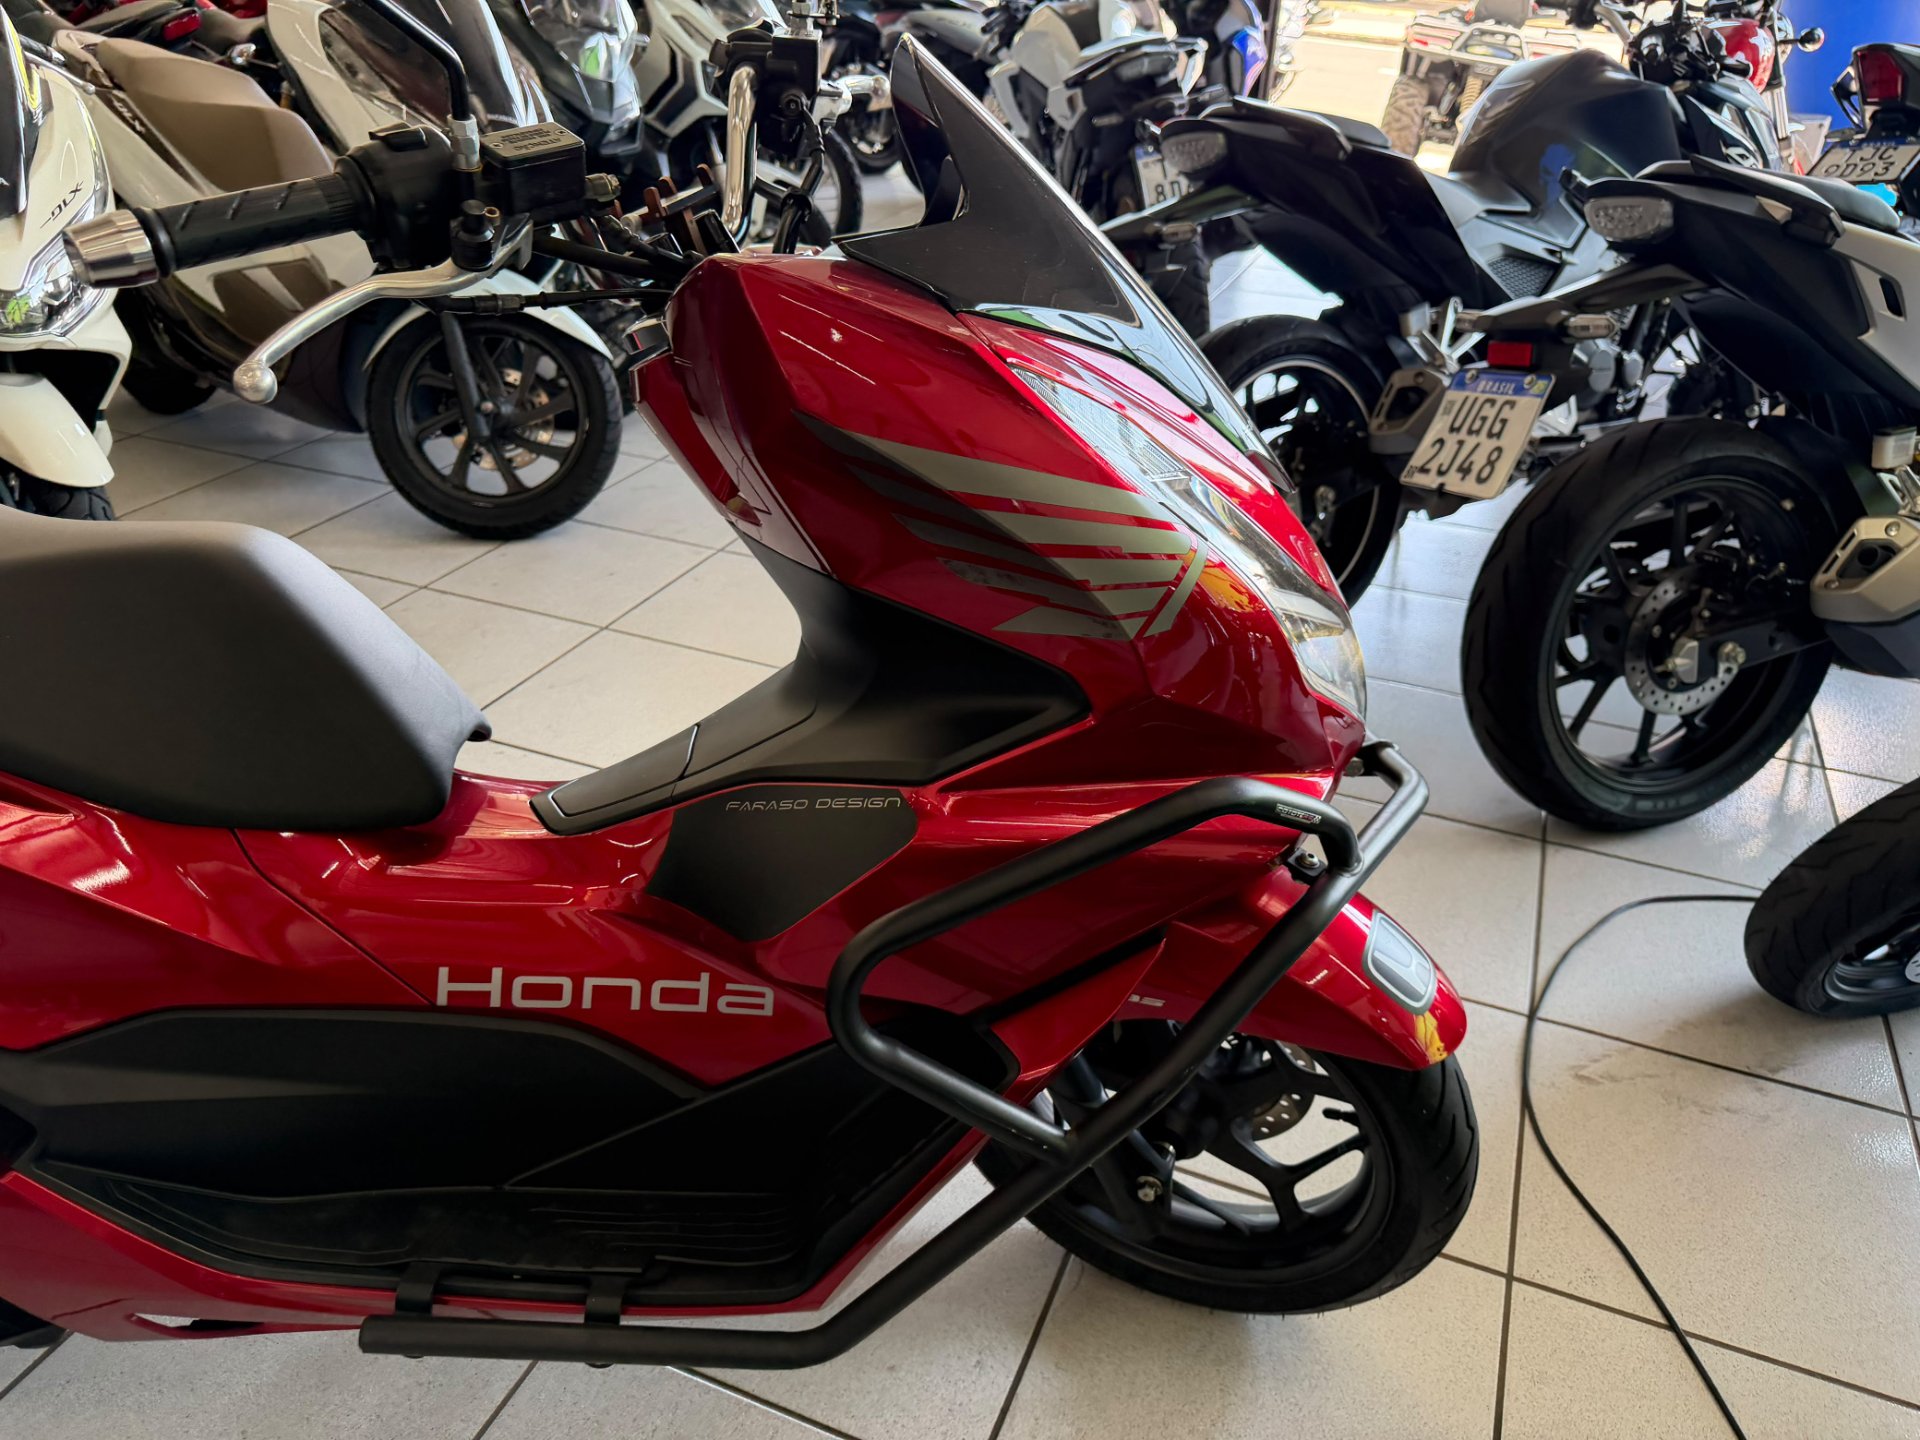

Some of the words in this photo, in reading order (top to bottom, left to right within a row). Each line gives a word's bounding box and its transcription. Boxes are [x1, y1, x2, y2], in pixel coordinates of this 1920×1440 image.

[50, 181, 84, 221] DLX
[1476, 379, 1516, 395] BRASIL
[1448, 395, 1517, 441] UGG
[1416, 437, 1504, 485] 2J48
[725, 799, 809, 812] FARASO
[815, 797, 901, 810] DESIGN
[436, 966, 775, 1016] Honda
